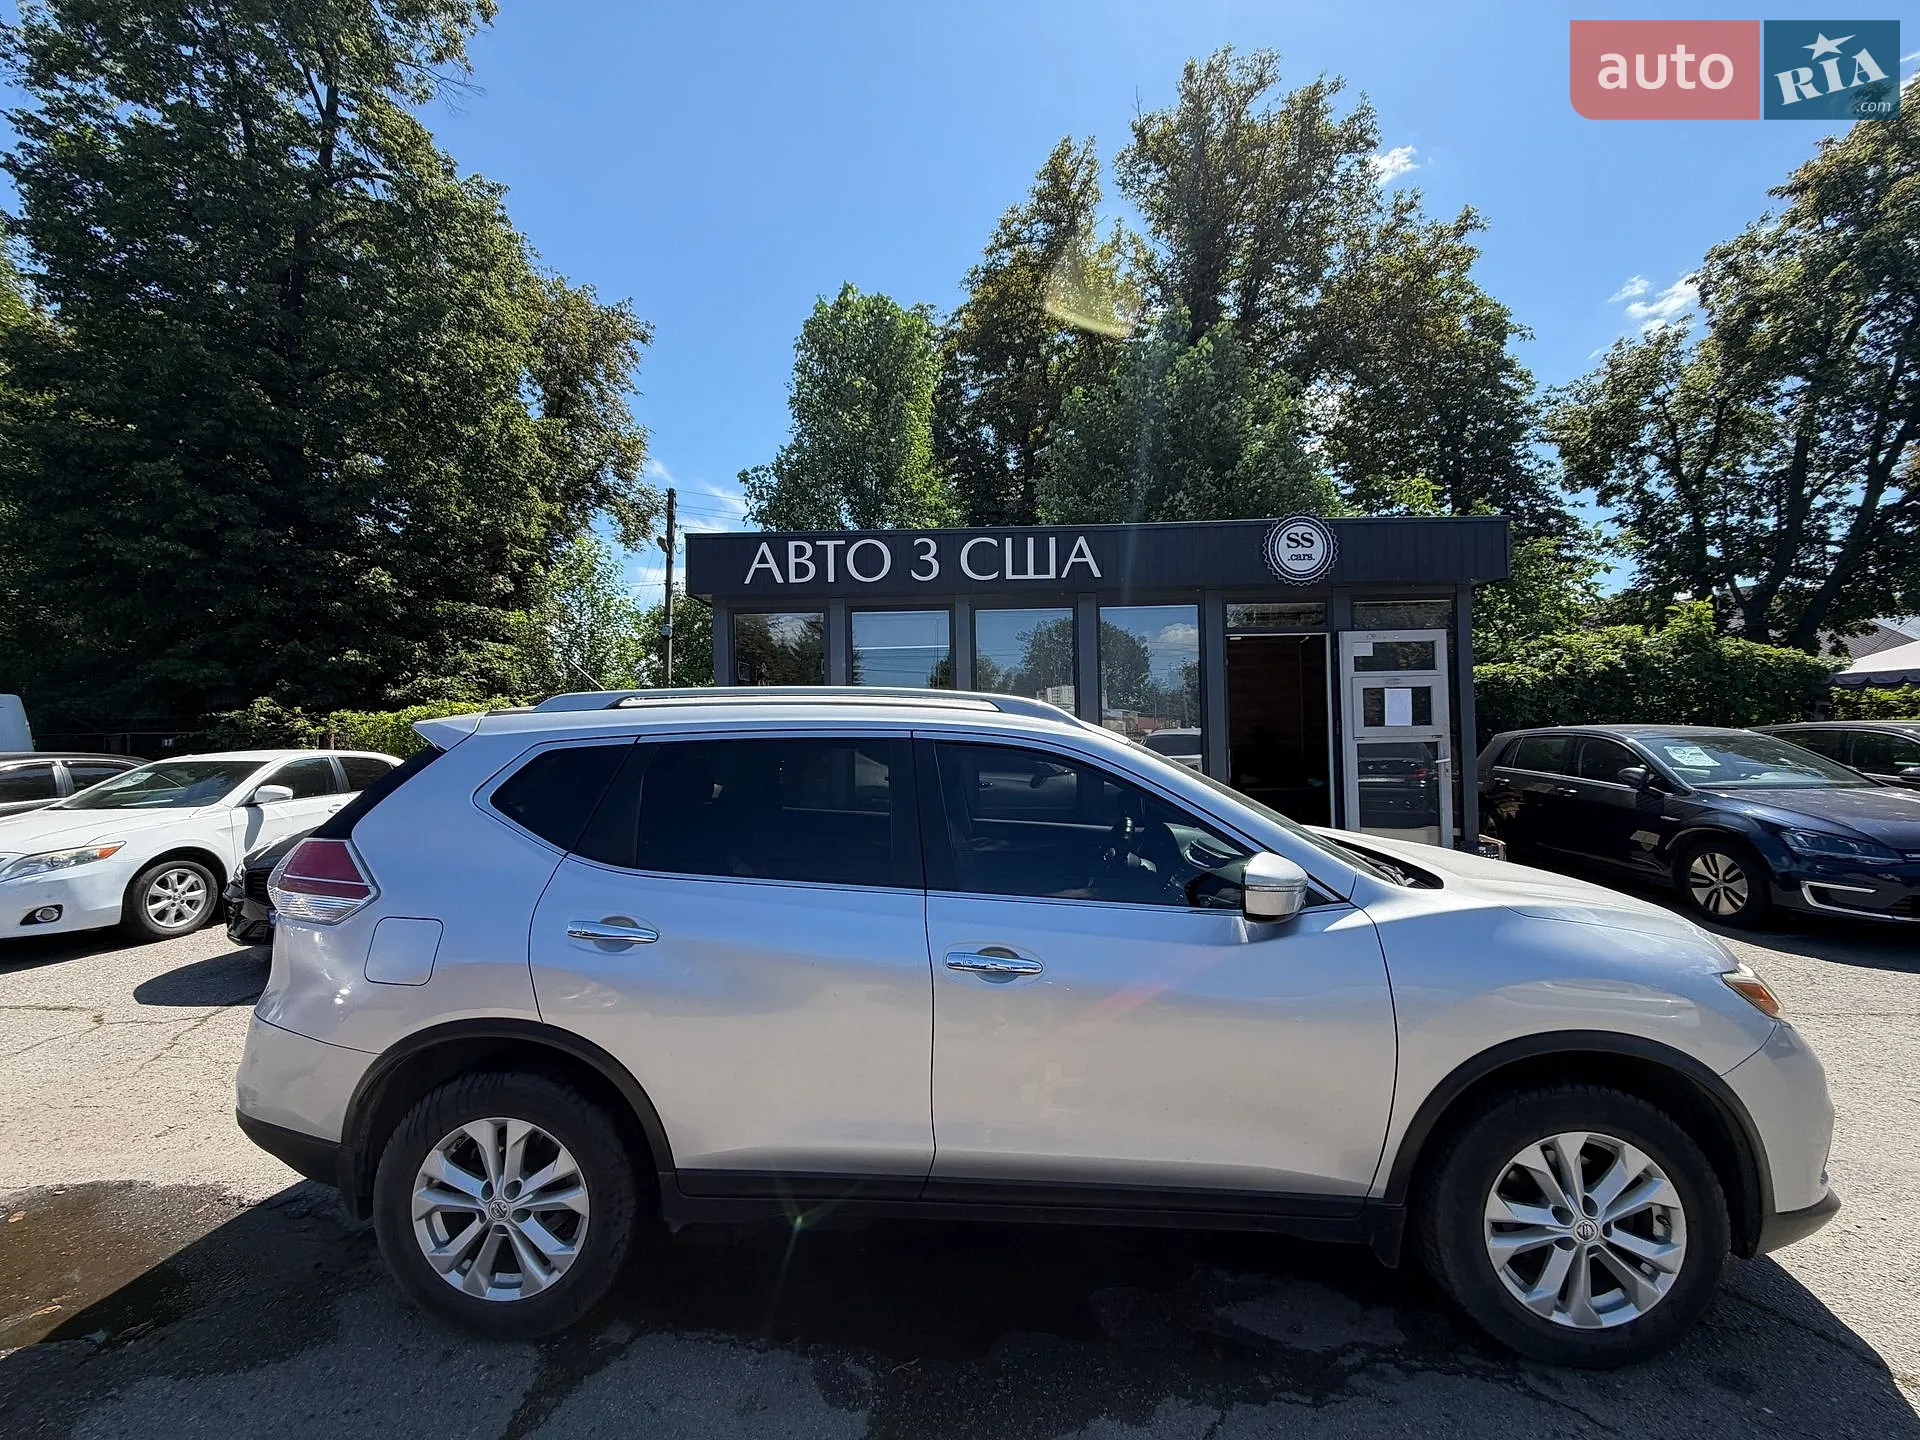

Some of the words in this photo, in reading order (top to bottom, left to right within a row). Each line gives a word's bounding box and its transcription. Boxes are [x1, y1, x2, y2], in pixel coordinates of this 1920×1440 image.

[1286, 532, 1315, 549] SS
[744, 538, 892, 584] АВТО
[960, 536, 1102, 580] США
